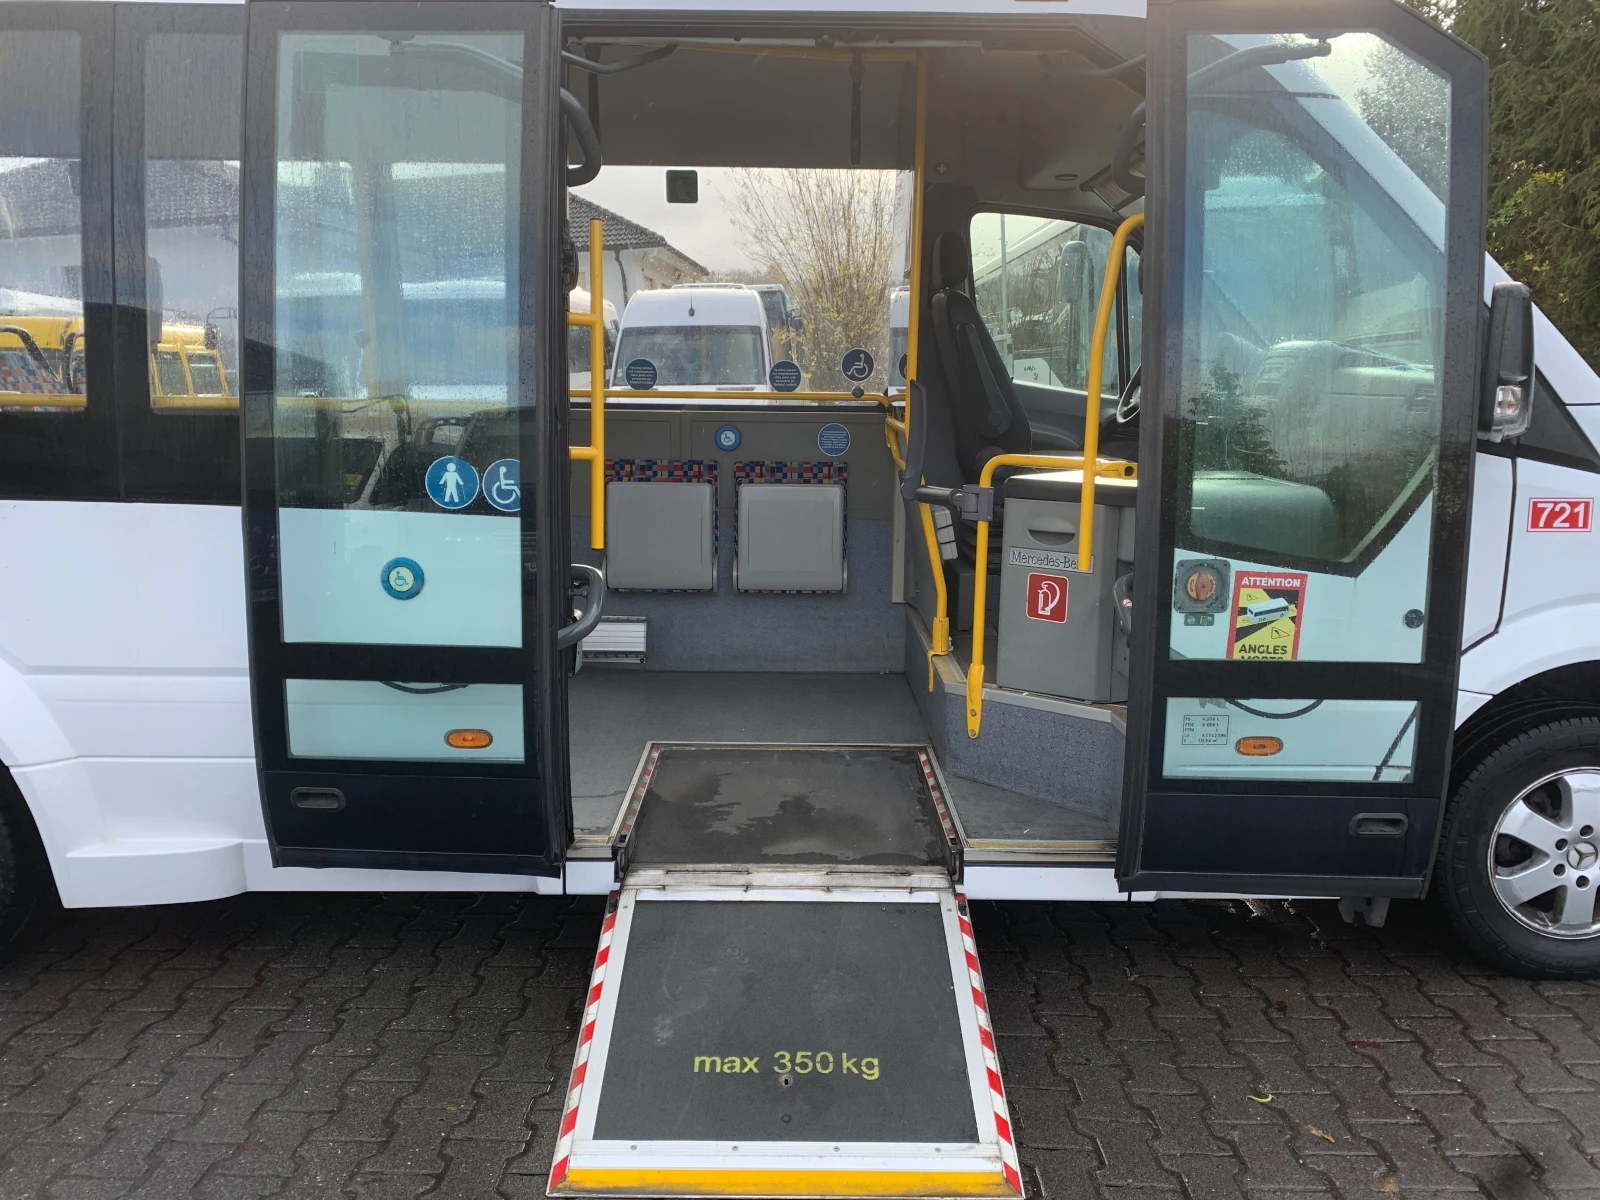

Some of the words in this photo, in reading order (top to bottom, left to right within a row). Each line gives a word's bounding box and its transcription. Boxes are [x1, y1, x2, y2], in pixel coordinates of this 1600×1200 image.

[1537, 502, 1585, 527] 721
[1012, 550, 1079, 569] Mercedes-Be
[1241, 576, 1301, 588] ATTENTION
[1239, 643, 1288, 655] ANGLES
[693, 1055, 760, 1073] max
